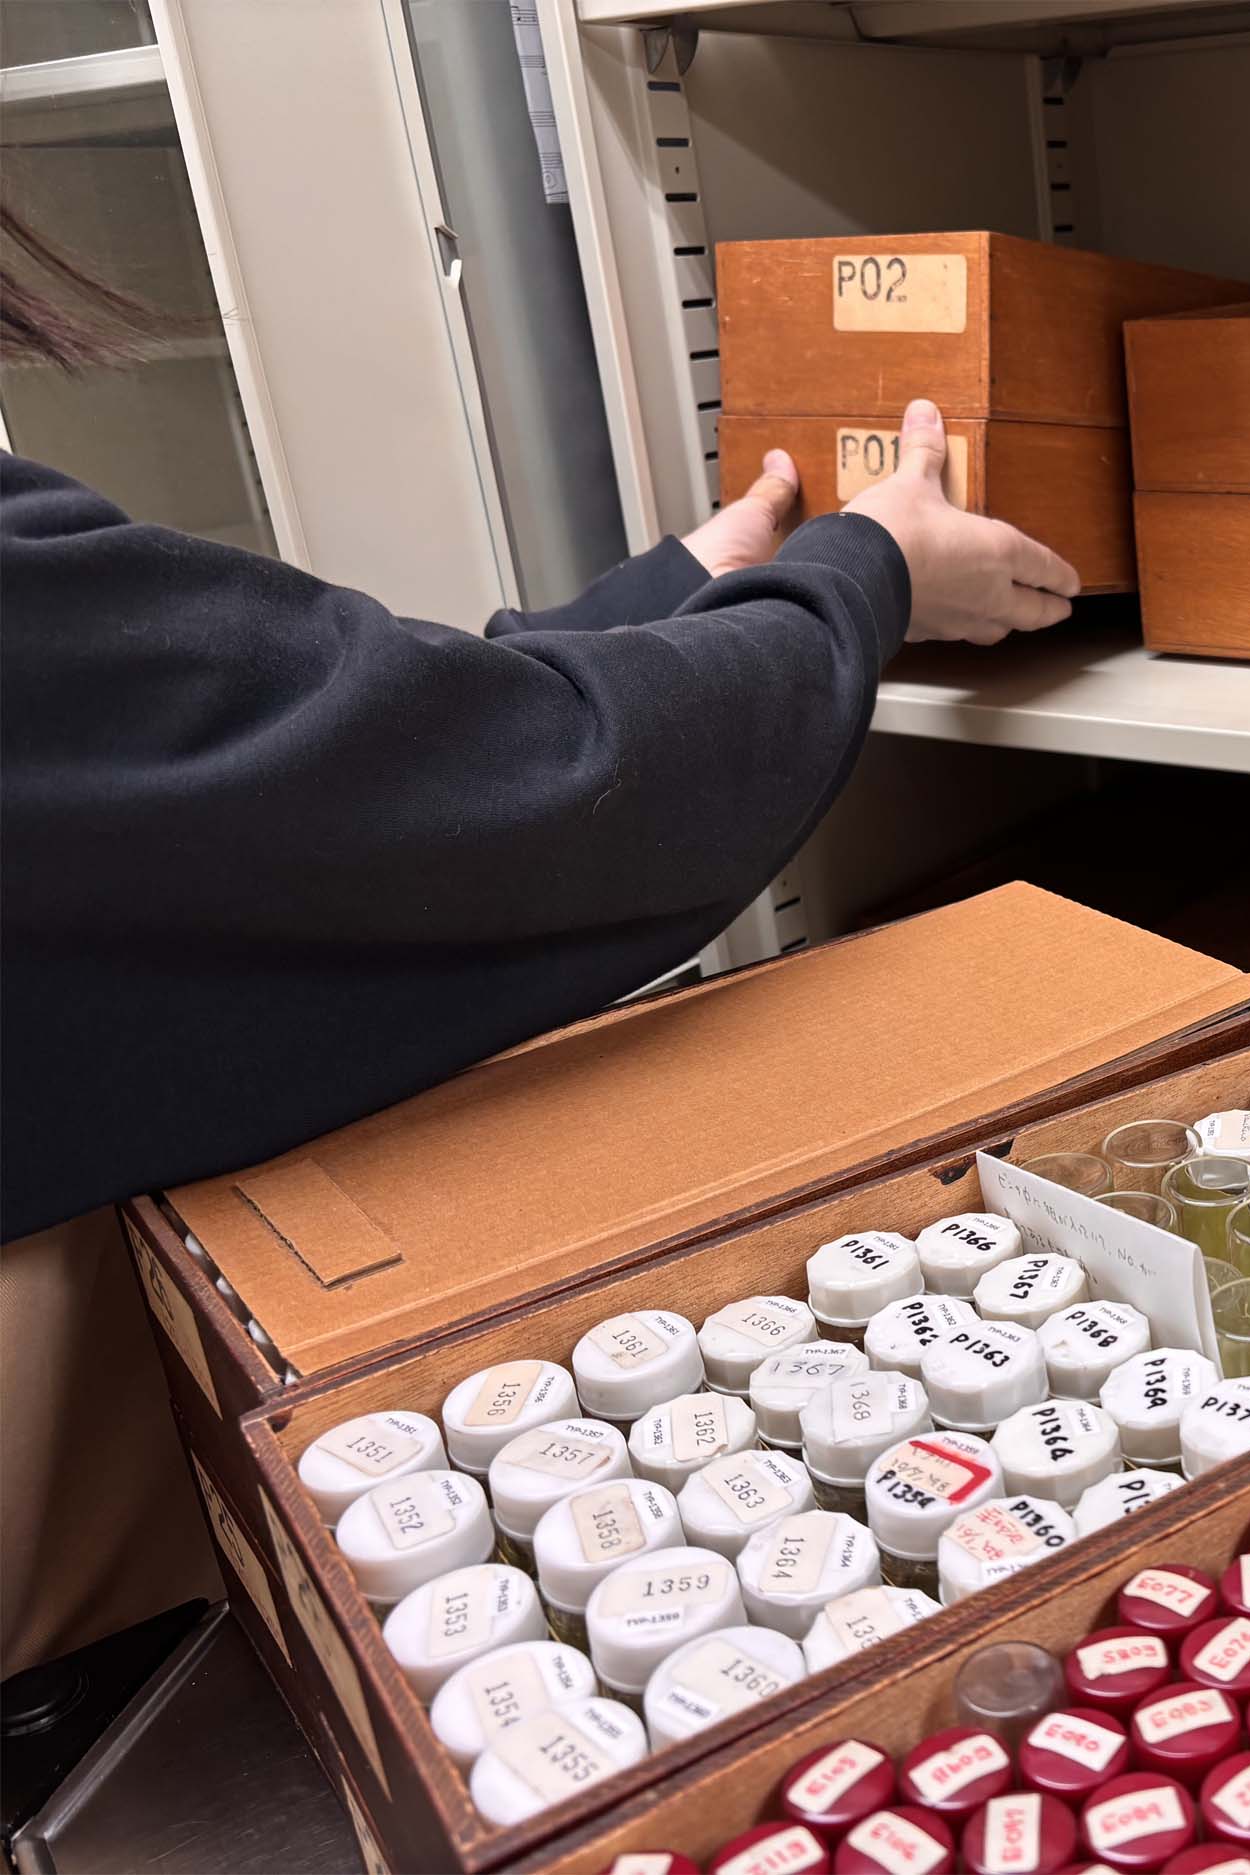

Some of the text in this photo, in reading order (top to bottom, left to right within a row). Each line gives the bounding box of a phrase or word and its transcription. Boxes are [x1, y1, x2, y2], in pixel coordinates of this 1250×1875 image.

[838, 257, 907, 302] P02
[841, 434, 900, 477] P01
[841, 1239, 889, 1270] P1361
[941, 1223, 996, 1251] P1366
[1010, 1259, 1048, 1300] P1367
[741, 1312, 788, 1336] 1366
[1065, 1311, 1118, 1347] P1368
[612, 1329, 649, 1358] 1361
[950, 1333, 1010, 1367] P1363
[487, 1382, 522, 1417] 1356
[1144, 1357, 1168, 1410] P1369
[694, 1411, 717, 1447] 1362
[346, 1436, 393, 1464] 1351
[539, 1442, 595, 1465] 1357
[724, 1473, 765, 1509] 1363
[389, 1496, 424, 1535] 1352
[592, 1509, 622, 1549] 1358
[1009, 1500, 1065, 1548] P1360
[771, 1536, 805, 1579] 1364
[642, 1574, 711, 1598] 1359
[444, 1592, 469, 1637] 1353
[720, 1658, 783, 1699] 1360
[485, 1681, 521, 1728] 1354
[540, 1735, 600, 1783] 1355
